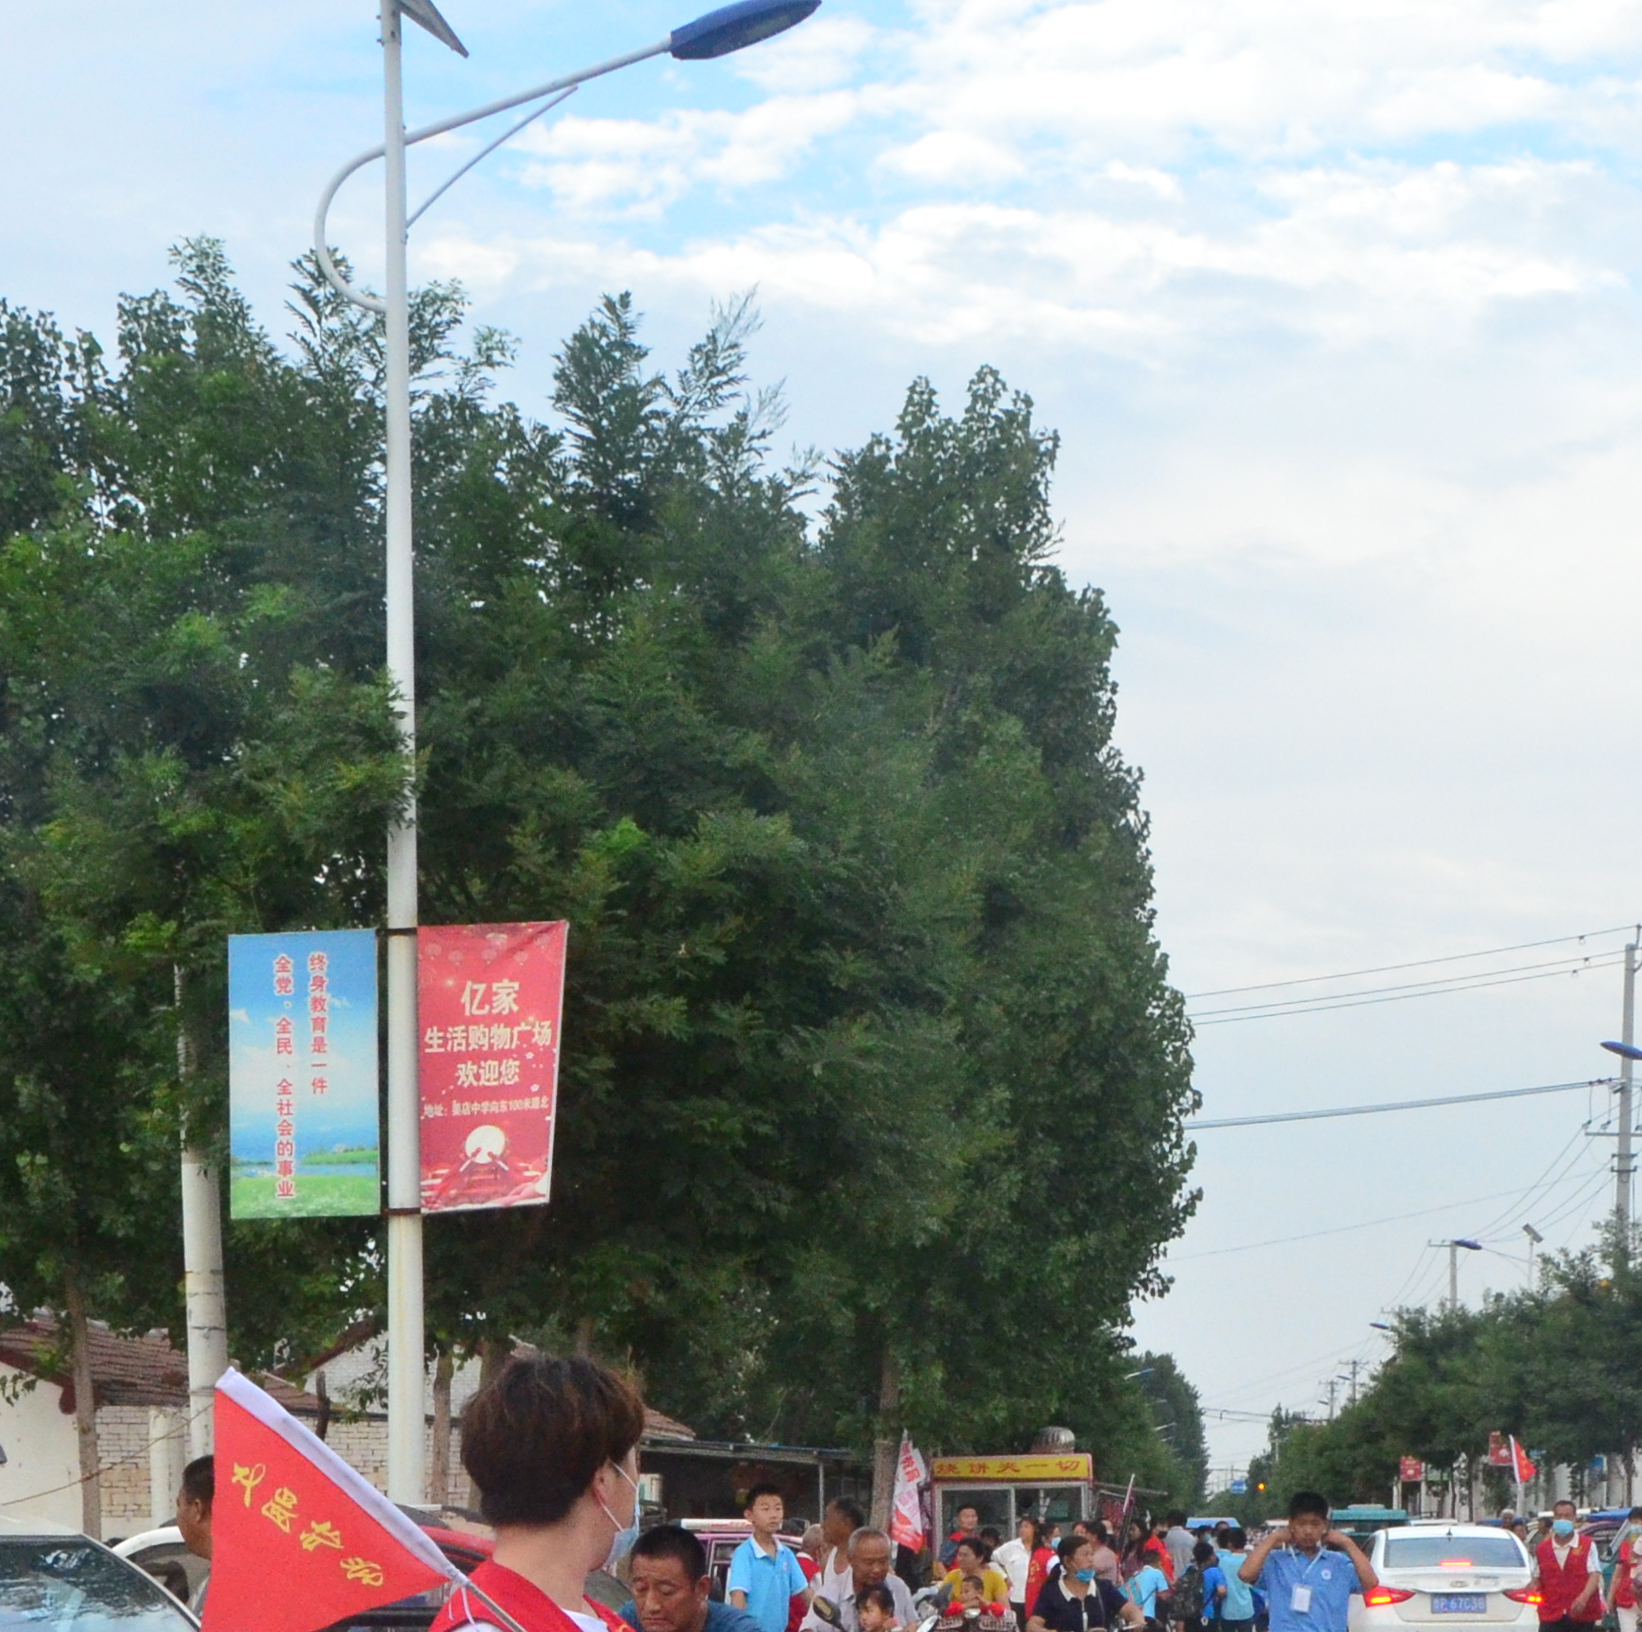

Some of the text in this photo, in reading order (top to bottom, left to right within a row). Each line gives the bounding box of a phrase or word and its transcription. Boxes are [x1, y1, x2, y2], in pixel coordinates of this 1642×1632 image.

[460, 979, 522, 1018] 亿家
[308, 952, 329, 1096] 终身教育是一件
[424, 1018, 552, 1056] 生活购物广场
[456, 1058, 521, 1088] 欢迎您
[936, 1459, 1081, 1475] 烧饼夹一切
